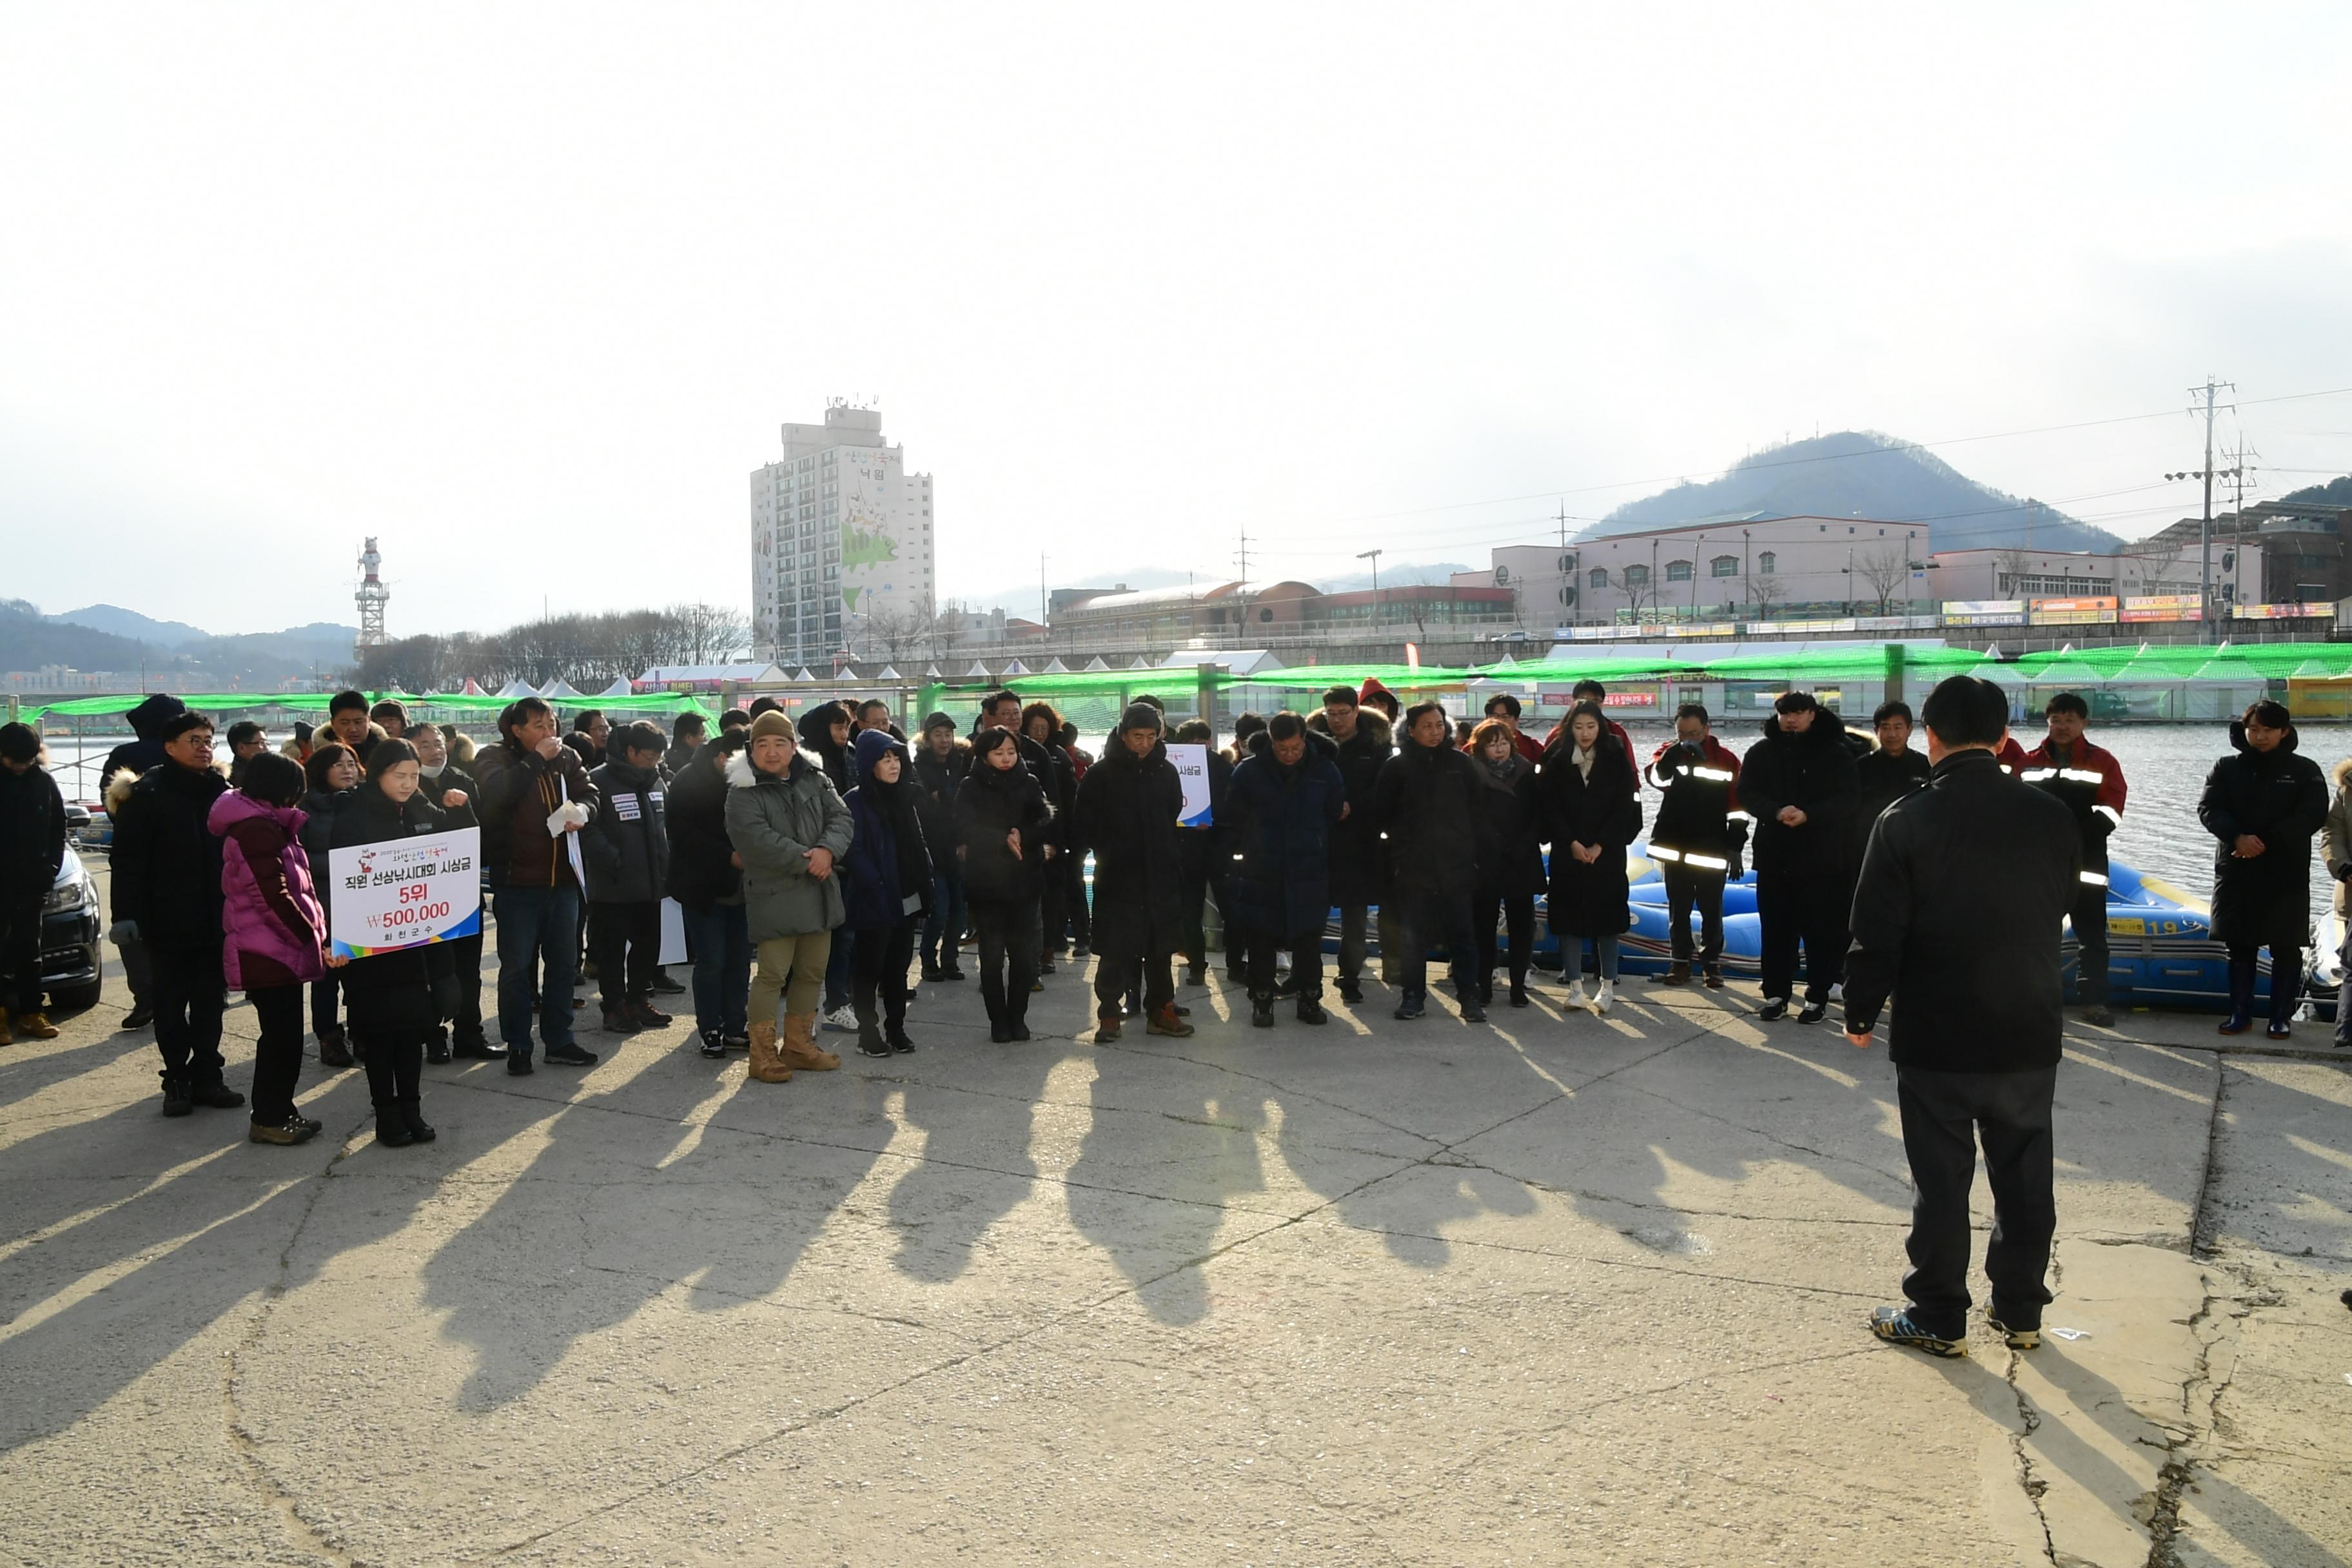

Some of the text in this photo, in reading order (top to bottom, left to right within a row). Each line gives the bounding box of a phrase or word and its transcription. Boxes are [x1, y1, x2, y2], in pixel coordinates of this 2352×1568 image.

[861, 468, 884, 480] 낙원
[1179, 765, 1201, 776] 시상금
[345, 857, 471, 890] 직원 선상낚시대회 시상금
[399, 883, 427, 903] 5위
[2148, 921, 2177, 934] 19
